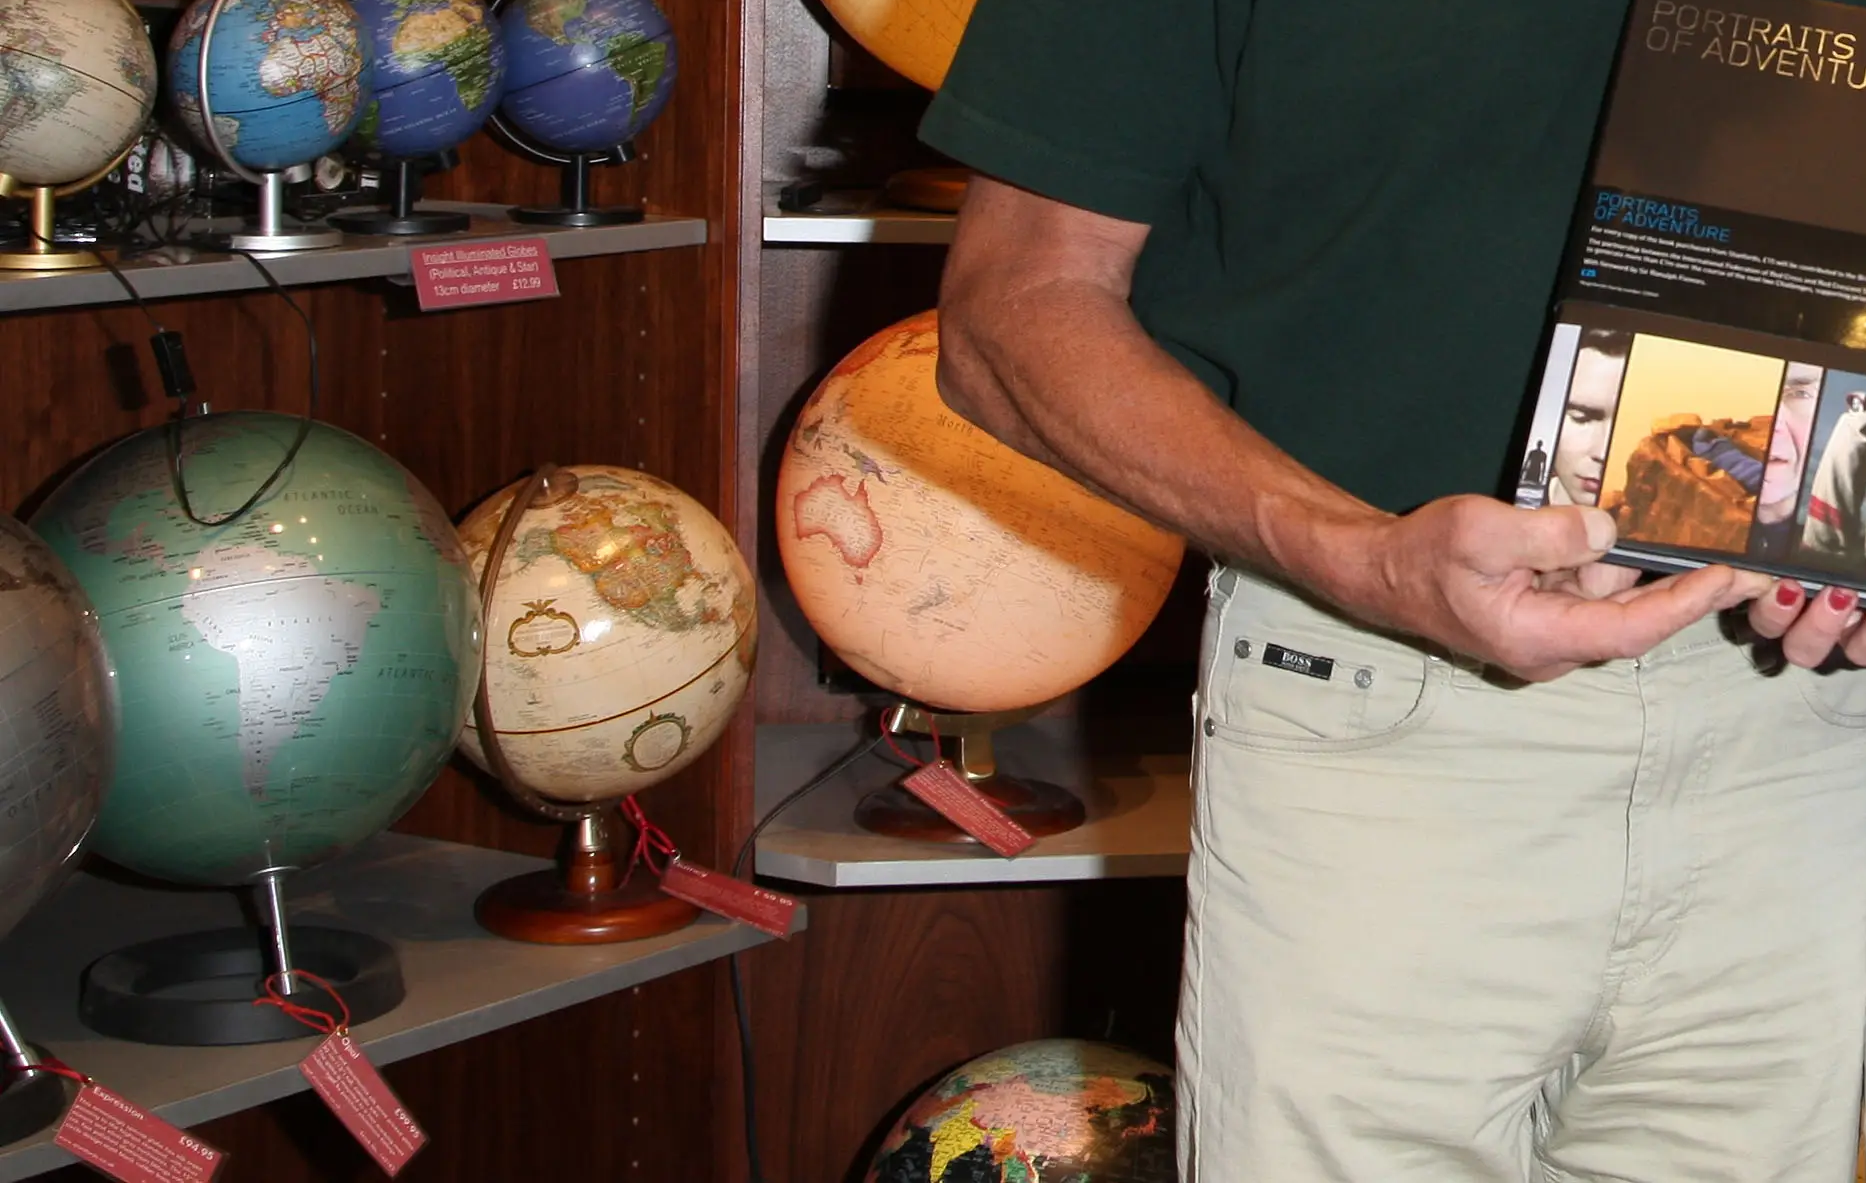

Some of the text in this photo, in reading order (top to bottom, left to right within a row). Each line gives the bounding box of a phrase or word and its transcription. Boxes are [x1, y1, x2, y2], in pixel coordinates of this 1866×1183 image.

[1646, 26, 1695, 54] OF
[1652, 0, 1857, 60] PORTRAITS
[1597, 192, 1699, 221] PORTRAITS
[1594, 206, 1731, 242] OF ADVENTURE
[422, 245, 538, 264] Insight Illuminated Globes
[429, 261, 539, 280] (Political, Antique & Star)
[434, 277, 541, 296] 13cm diameter £12.99
[284, 490, 353, 502] ATLANTIC
[337, 504, 379, 515] OCEAN
[1282, 650, 1312, 667] BOSS
[337, 1035, 422, 1139] Opal £99.95
[91, 1085, 215, 1161] Expression £94.95
